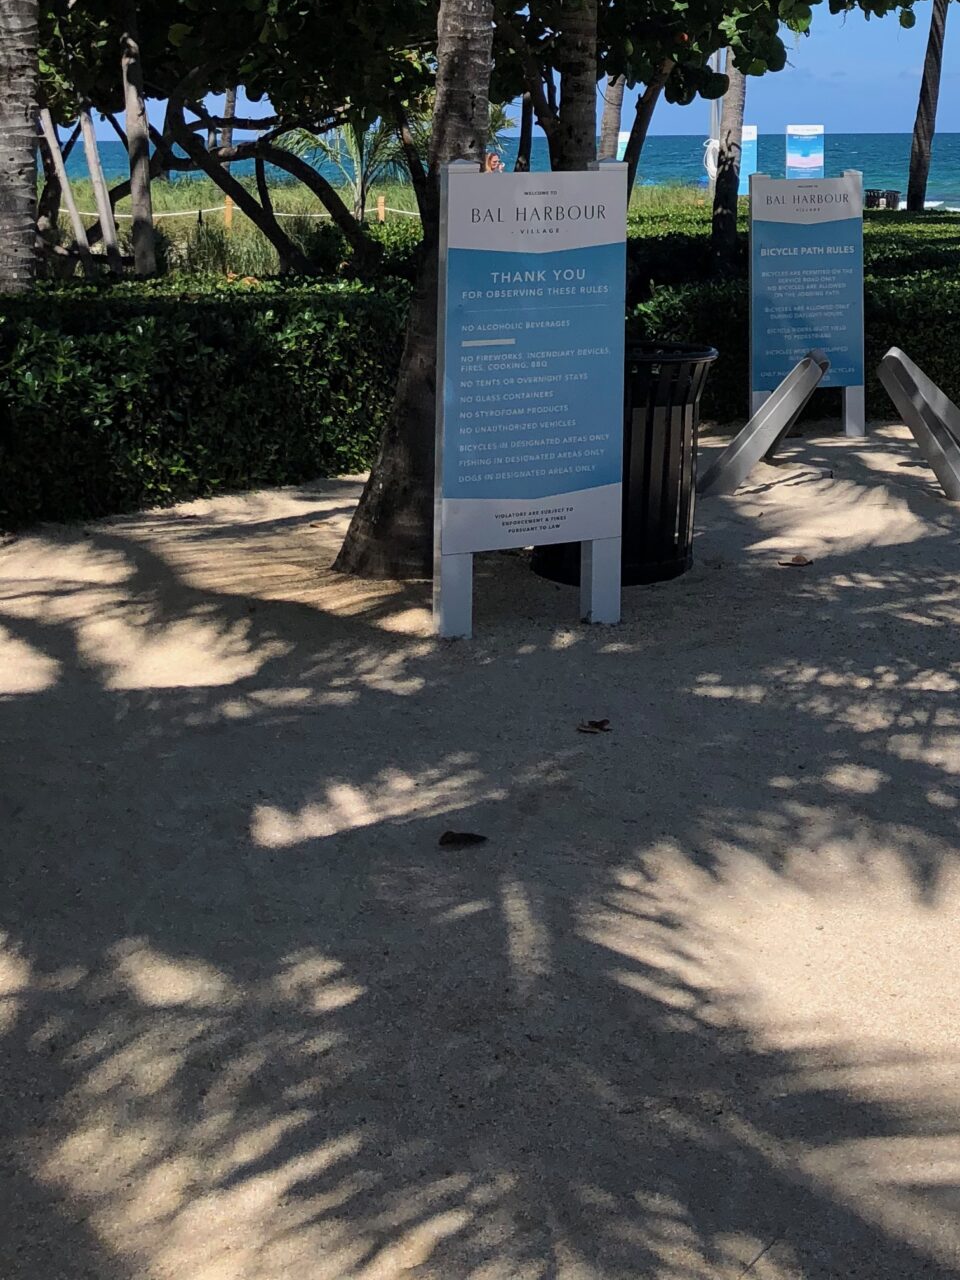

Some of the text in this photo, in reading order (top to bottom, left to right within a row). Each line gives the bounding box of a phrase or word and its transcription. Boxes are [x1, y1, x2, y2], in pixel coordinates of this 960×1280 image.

[792, 193, 849, 205] HARBOUR
[471, 204, 607, 223] BAL HARBOUR
[520, 227, 560, 235] VILLAGE
[760, 245, 855, 257] BICYCLE PATH RULES
[491, 268, 586, 284] THANK YOU
[462, 285, 609, 300] FOR OBSERVING THESE RULES
[461, 320, 571, 332] NO ALCOHOLIC BEVERAGES
[460, 355, 474, 363] NO
[527, 350, 575, 359] INCENDIARY
[530, 360, 548, 368] BBQ
[460, 372, 588, 388] NO TENTS OR OVERNIGHT STAYS
[459, 390, 554, 404] NO GLASS CONTAINERS
[459, 405, 569, 419] NO STYROFOAM PRODUCTS
[459, 419, 576, 434] NO UNAUTHORIZED VEHICLES
[459, 443, 497, 452] BICYCLES
[510, 437, 561, 447] DESIGNATED
[562, 435, 588, 444] AREAS
[589, 433, 610, 441] ONLY
[458, 448, 605, 467] FISHING IN DESIGNATED AREAS ONLY
[458, 474, 482, 483] DOGS
[495, 469, 546, 480] DESIGNATED
[548, 465, 574, 475] AREAS
[575, 464, 596, 473] ONLY
[495, 511, 527, 519] VIOLATORS
